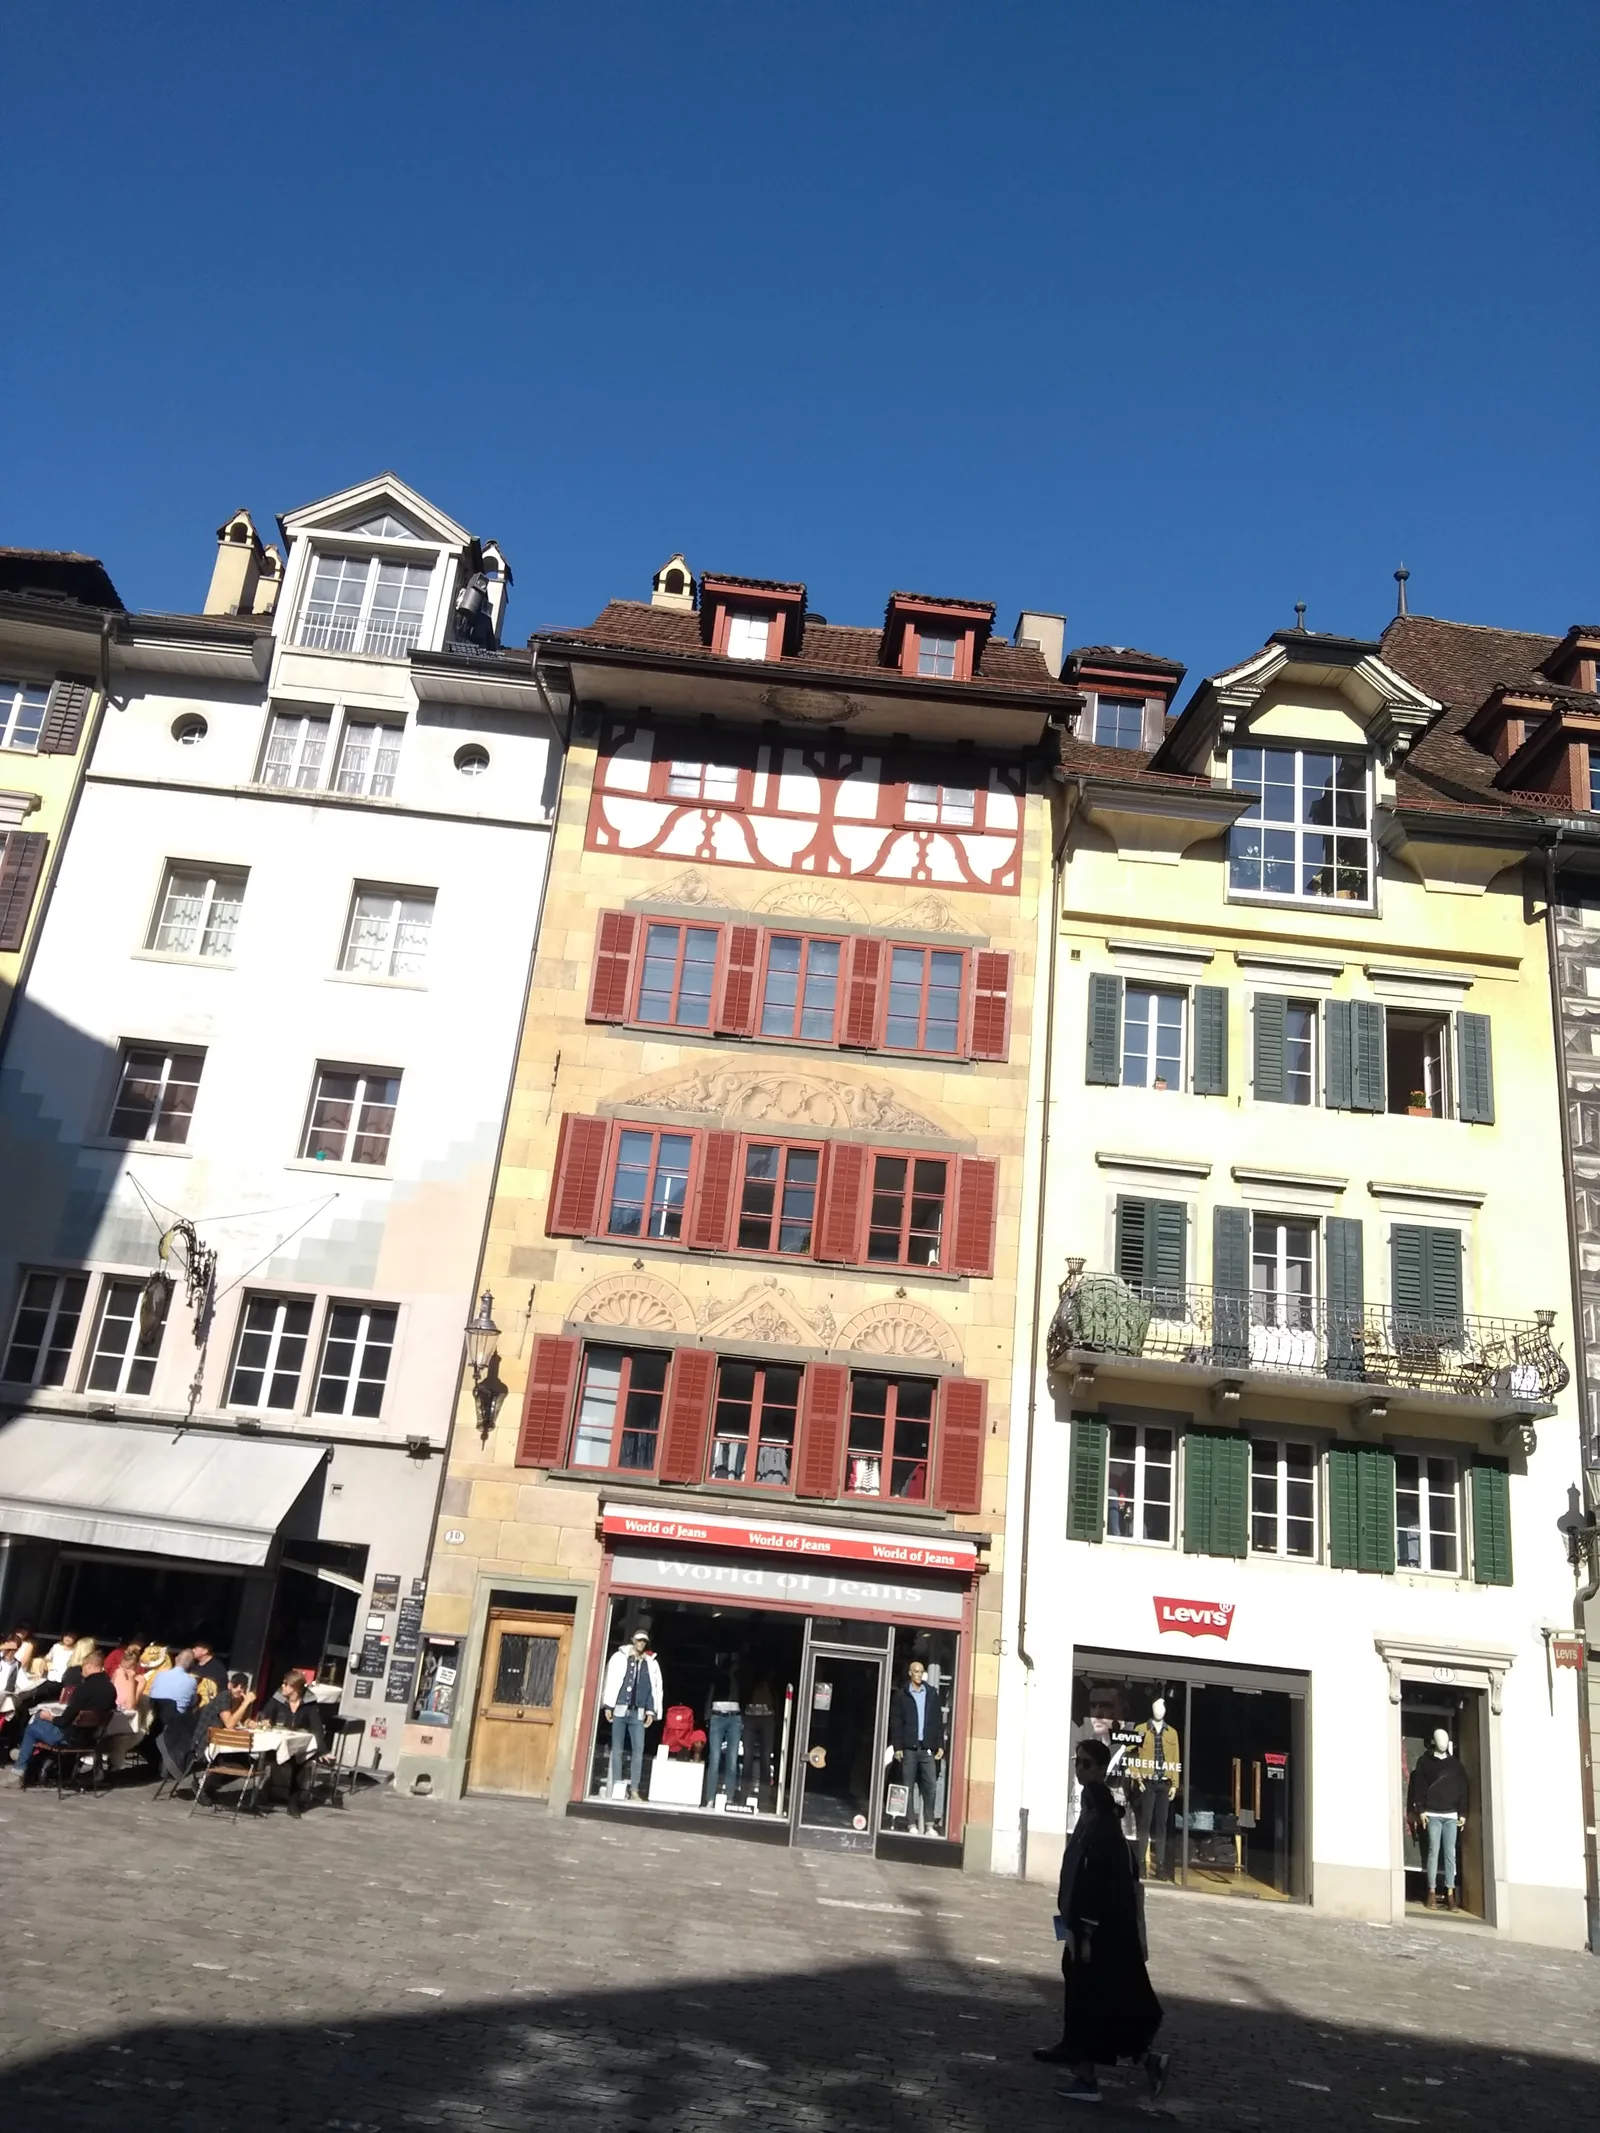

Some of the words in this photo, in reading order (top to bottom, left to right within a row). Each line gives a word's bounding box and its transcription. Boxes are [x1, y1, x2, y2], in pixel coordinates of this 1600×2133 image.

[450, 1531, 460, 1540] 10
[625, 1519, 660, 1533] World
[661, 1525, 675, 1535] of
[676, 1526, 707, 1539] Jeans
[748, 1533, 784, 1547] World
[785, 1538, 799, 1549] of
[799, 1538, 831, 1551] Jeans
[872, 1545, 907, 1560] World
[909, 1551, 923, 1561] of
[924, 1551, 955, 1565] Jeans
[656, 1558, 763, 1585] World
[776, 1571, 811, 1590] of
[824, 1576, 922, 1601] Jeans
[1439, 1667, 1449, 1677] 11
